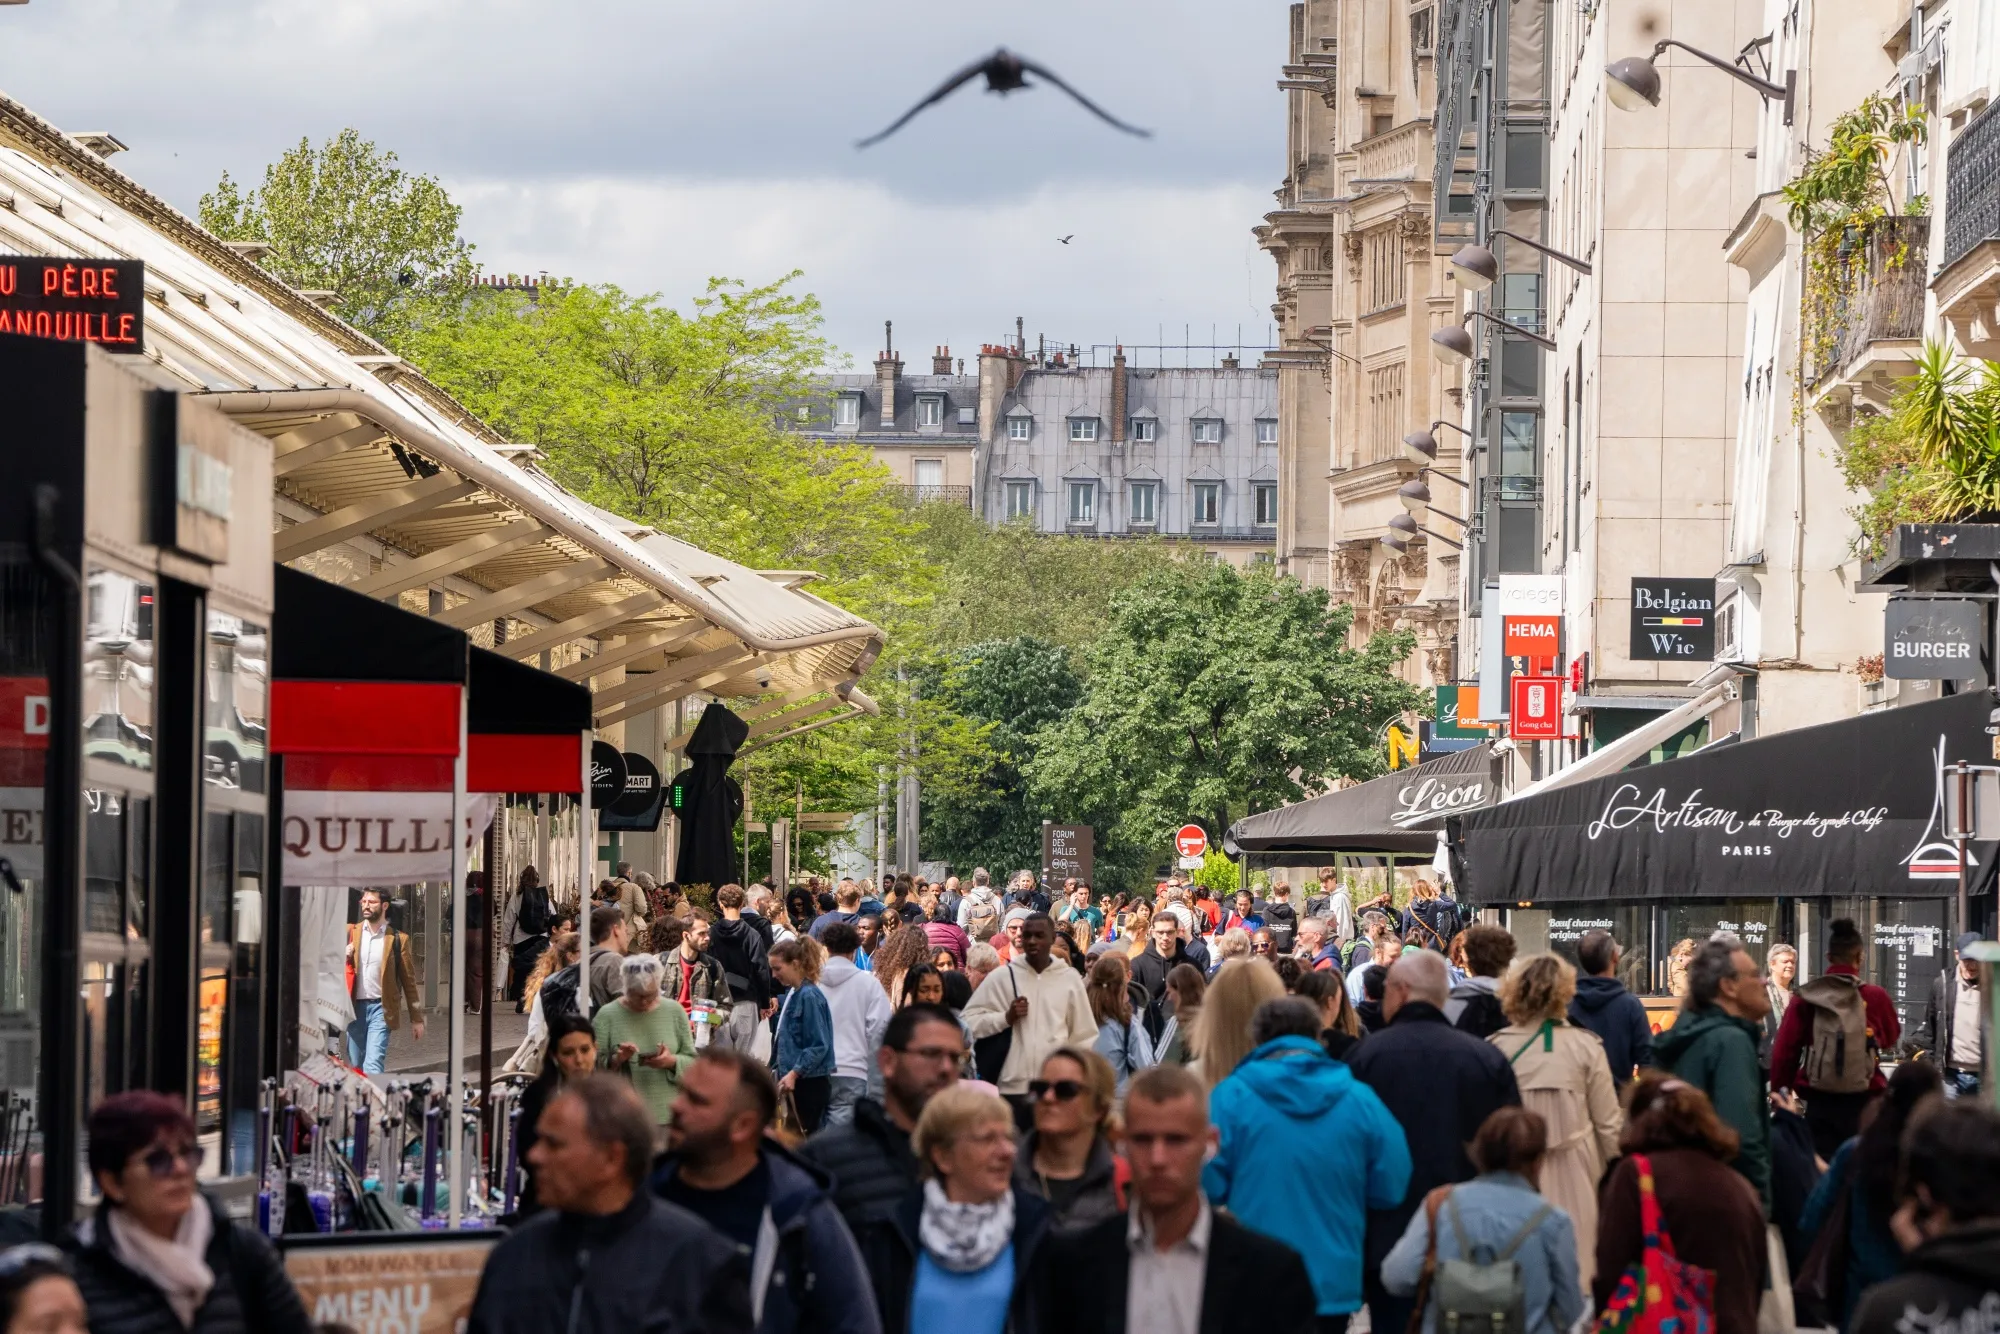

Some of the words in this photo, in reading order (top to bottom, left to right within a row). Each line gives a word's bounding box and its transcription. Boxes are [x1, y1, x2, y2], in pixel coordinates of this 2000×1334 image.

[44, 263, 119, 297] PÈRE
[1635, 588, 1712, 613] Belgian
[1508, 623, 1556, 637] HEMA
[1648, 633, 1695, 654] Wic
[1893, 642, 1970, 658] BURGER
[1520, 721, 1539, 729] Gong
[627, 777, 649, 786] MART
[1588, 784, 1744, 840] L'Artisan
[1802, 811, 1820, 826] des
[1851, 806, 1888, 832] Chefs
[1052, 830, 1075, 838] FORUM
[1052, 839, 1065, 847] DES
[1052, 847, 1077, 856] HALLES
[1722, 845, 1772, 856] PARIS
[1572, 918, 1614, 927] charolais
[1717, 920, 1739, 930] Vins
[1744, 921, 1767, 933] Softs
[1549, 930, 1581, 941] origine
[1745, 933, 1764, 944] Thé
[314, 1283, 431, 1324] MENU
